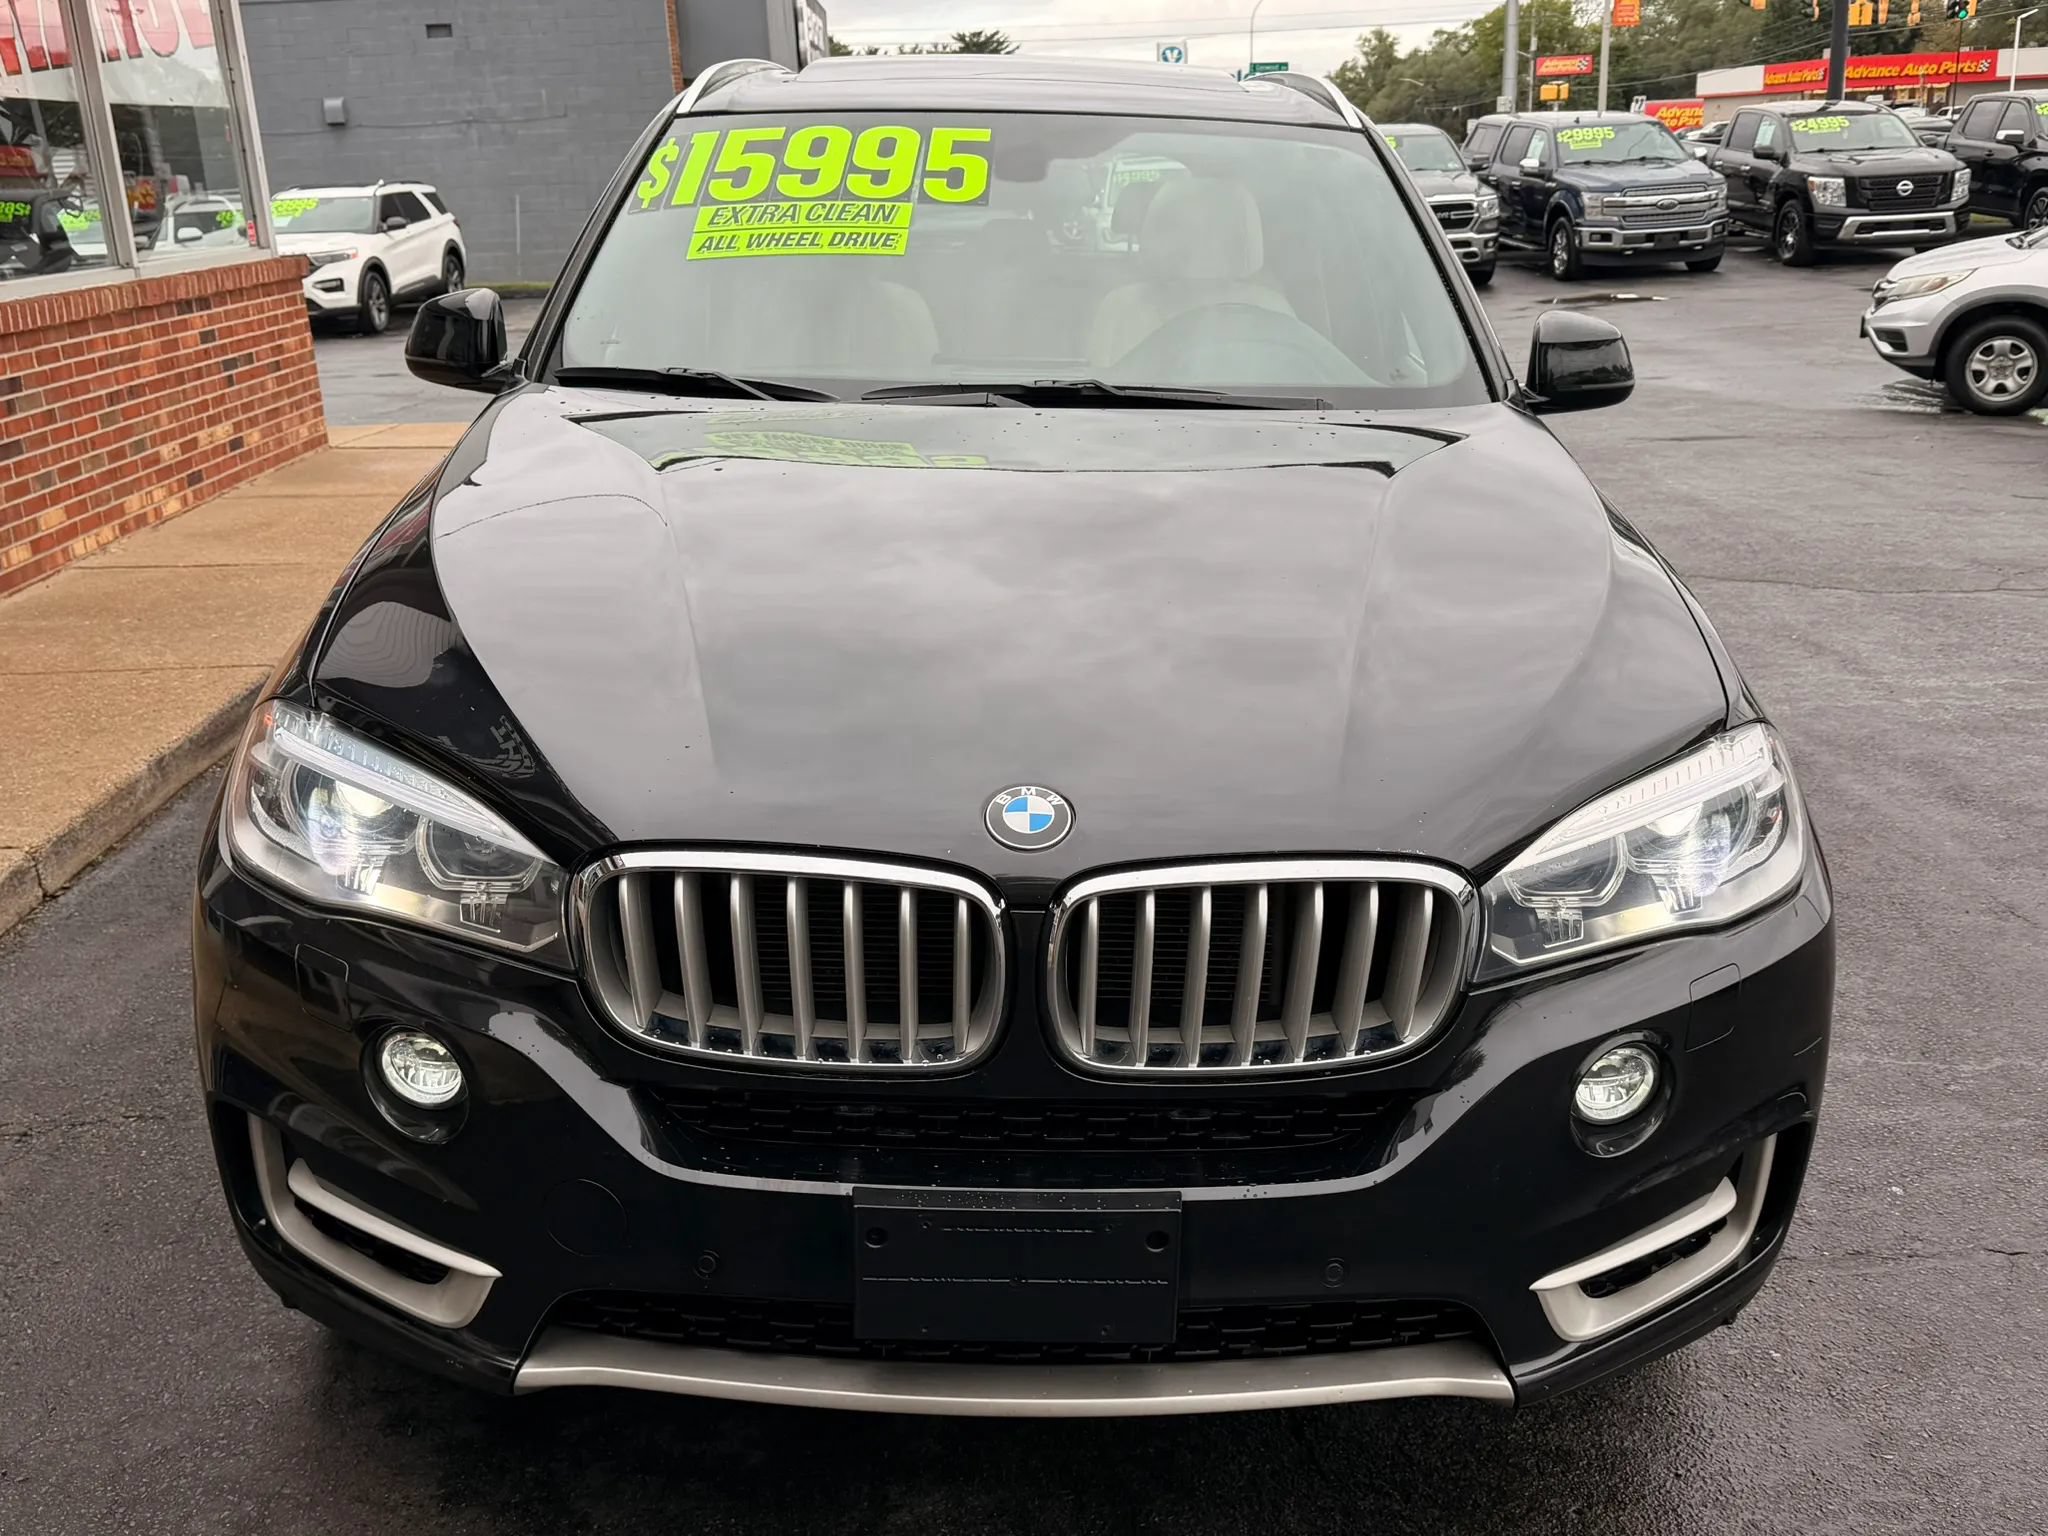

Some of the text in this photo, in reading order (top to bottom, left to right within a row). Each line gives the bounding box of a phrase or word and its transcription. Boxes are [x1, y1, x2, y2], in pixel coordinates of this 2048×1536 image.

[1846, 61, 1978, 79] Advance Auto Parts
[1790, 115, 1850, 131] $24995
[1556, 126, 1616, 142] $29995
[637, 125, 991, 208] $15995
[708, 203, 901, 227] EXTRA CLEAN
[697, 231, 902, 253] ALL WHEEL DRIVE
[995, 787, 1064, 806] BMW
